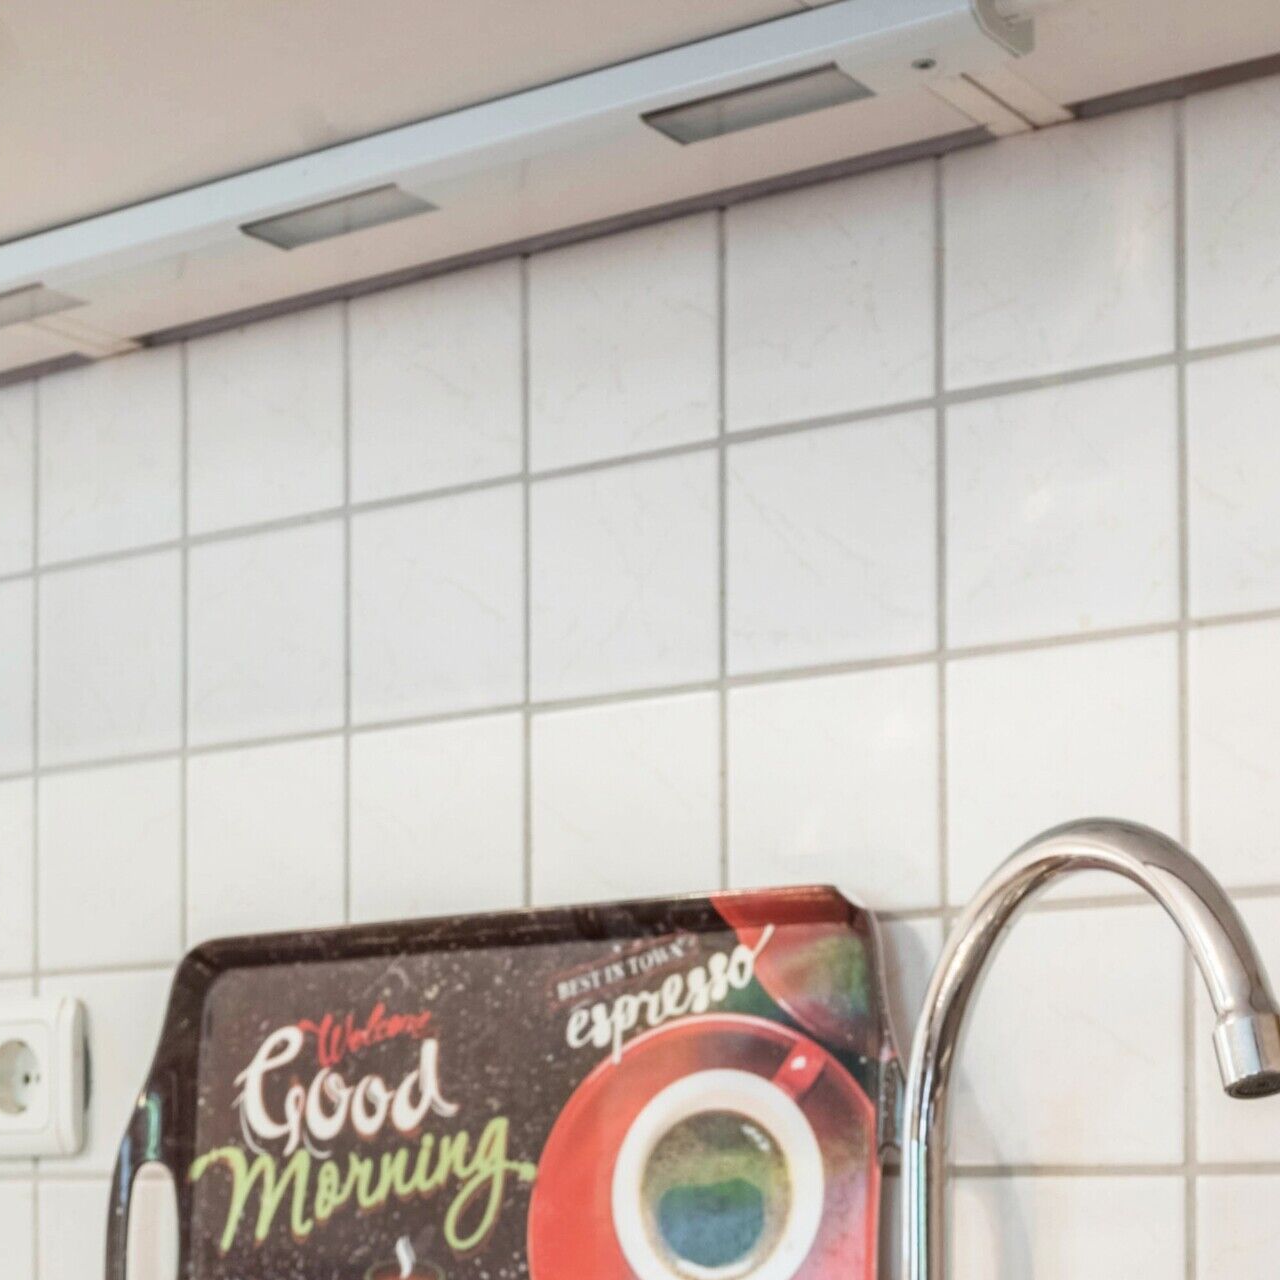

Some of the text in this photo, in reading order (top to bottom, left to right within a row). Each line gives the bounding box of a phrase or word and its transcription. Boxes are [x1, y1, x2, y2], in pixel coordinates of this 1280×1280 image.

[566, 923, 775, 1064] espresso
[232, 1025, 460, 1157] Good
[189, 1115, 536, 1251] Morning
